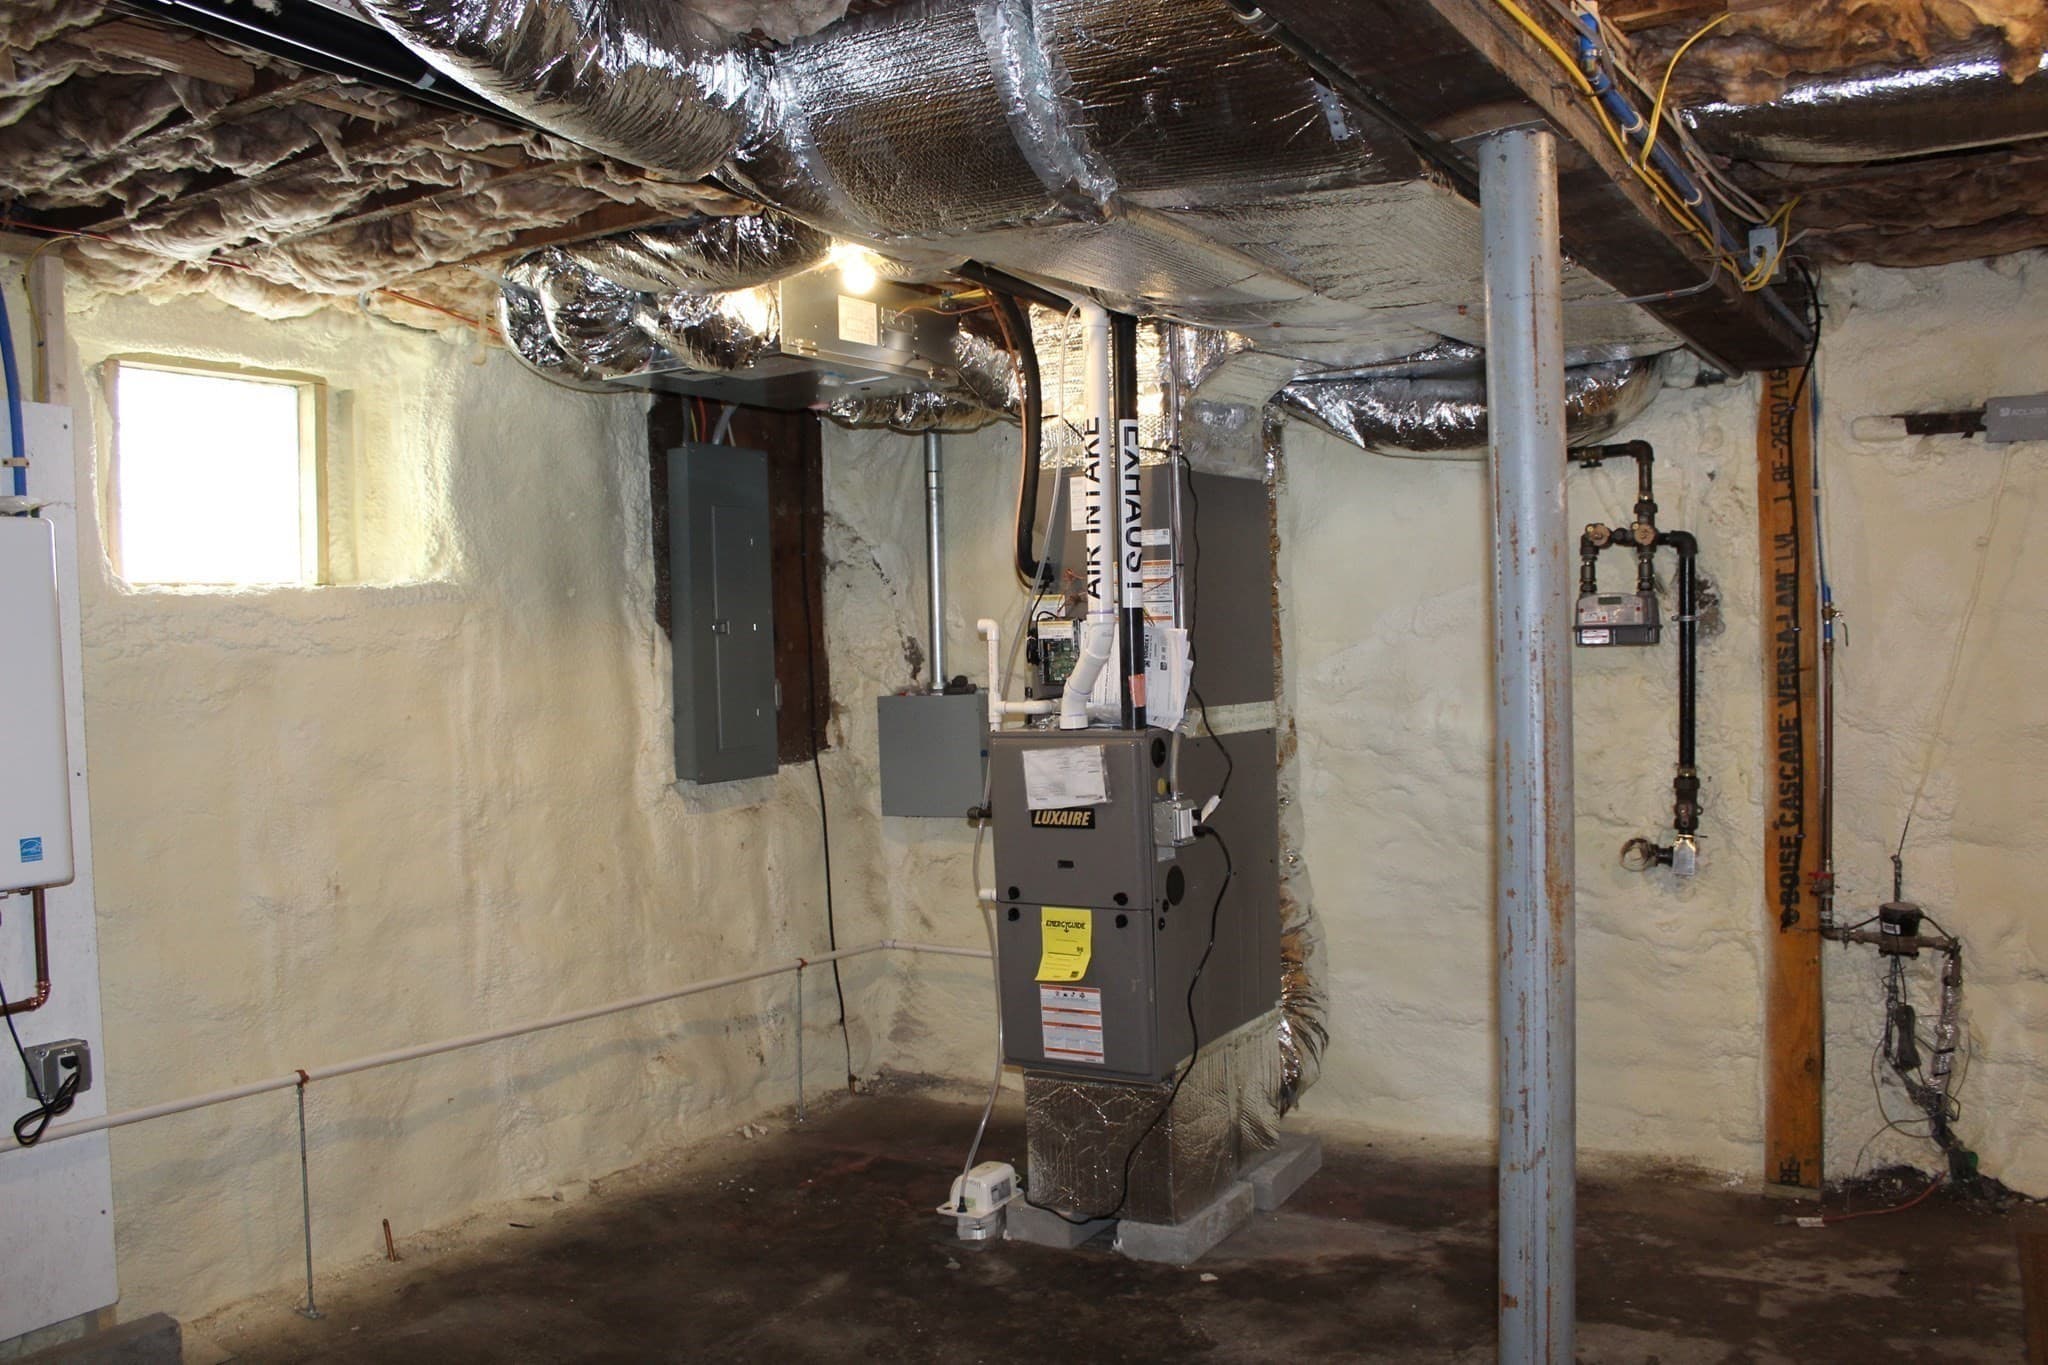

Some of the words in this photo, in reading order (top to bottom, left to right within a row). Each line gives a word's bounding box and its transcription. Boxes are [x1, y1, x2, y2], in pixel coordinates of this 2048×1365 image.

[1086, 545, 1101, 600] AIR
[1777, 719, 1800, 827] CASCADE
[1034, 810, 1091, 826] LUXAIRE
[1778, 835, 1800, 905] BOISE
